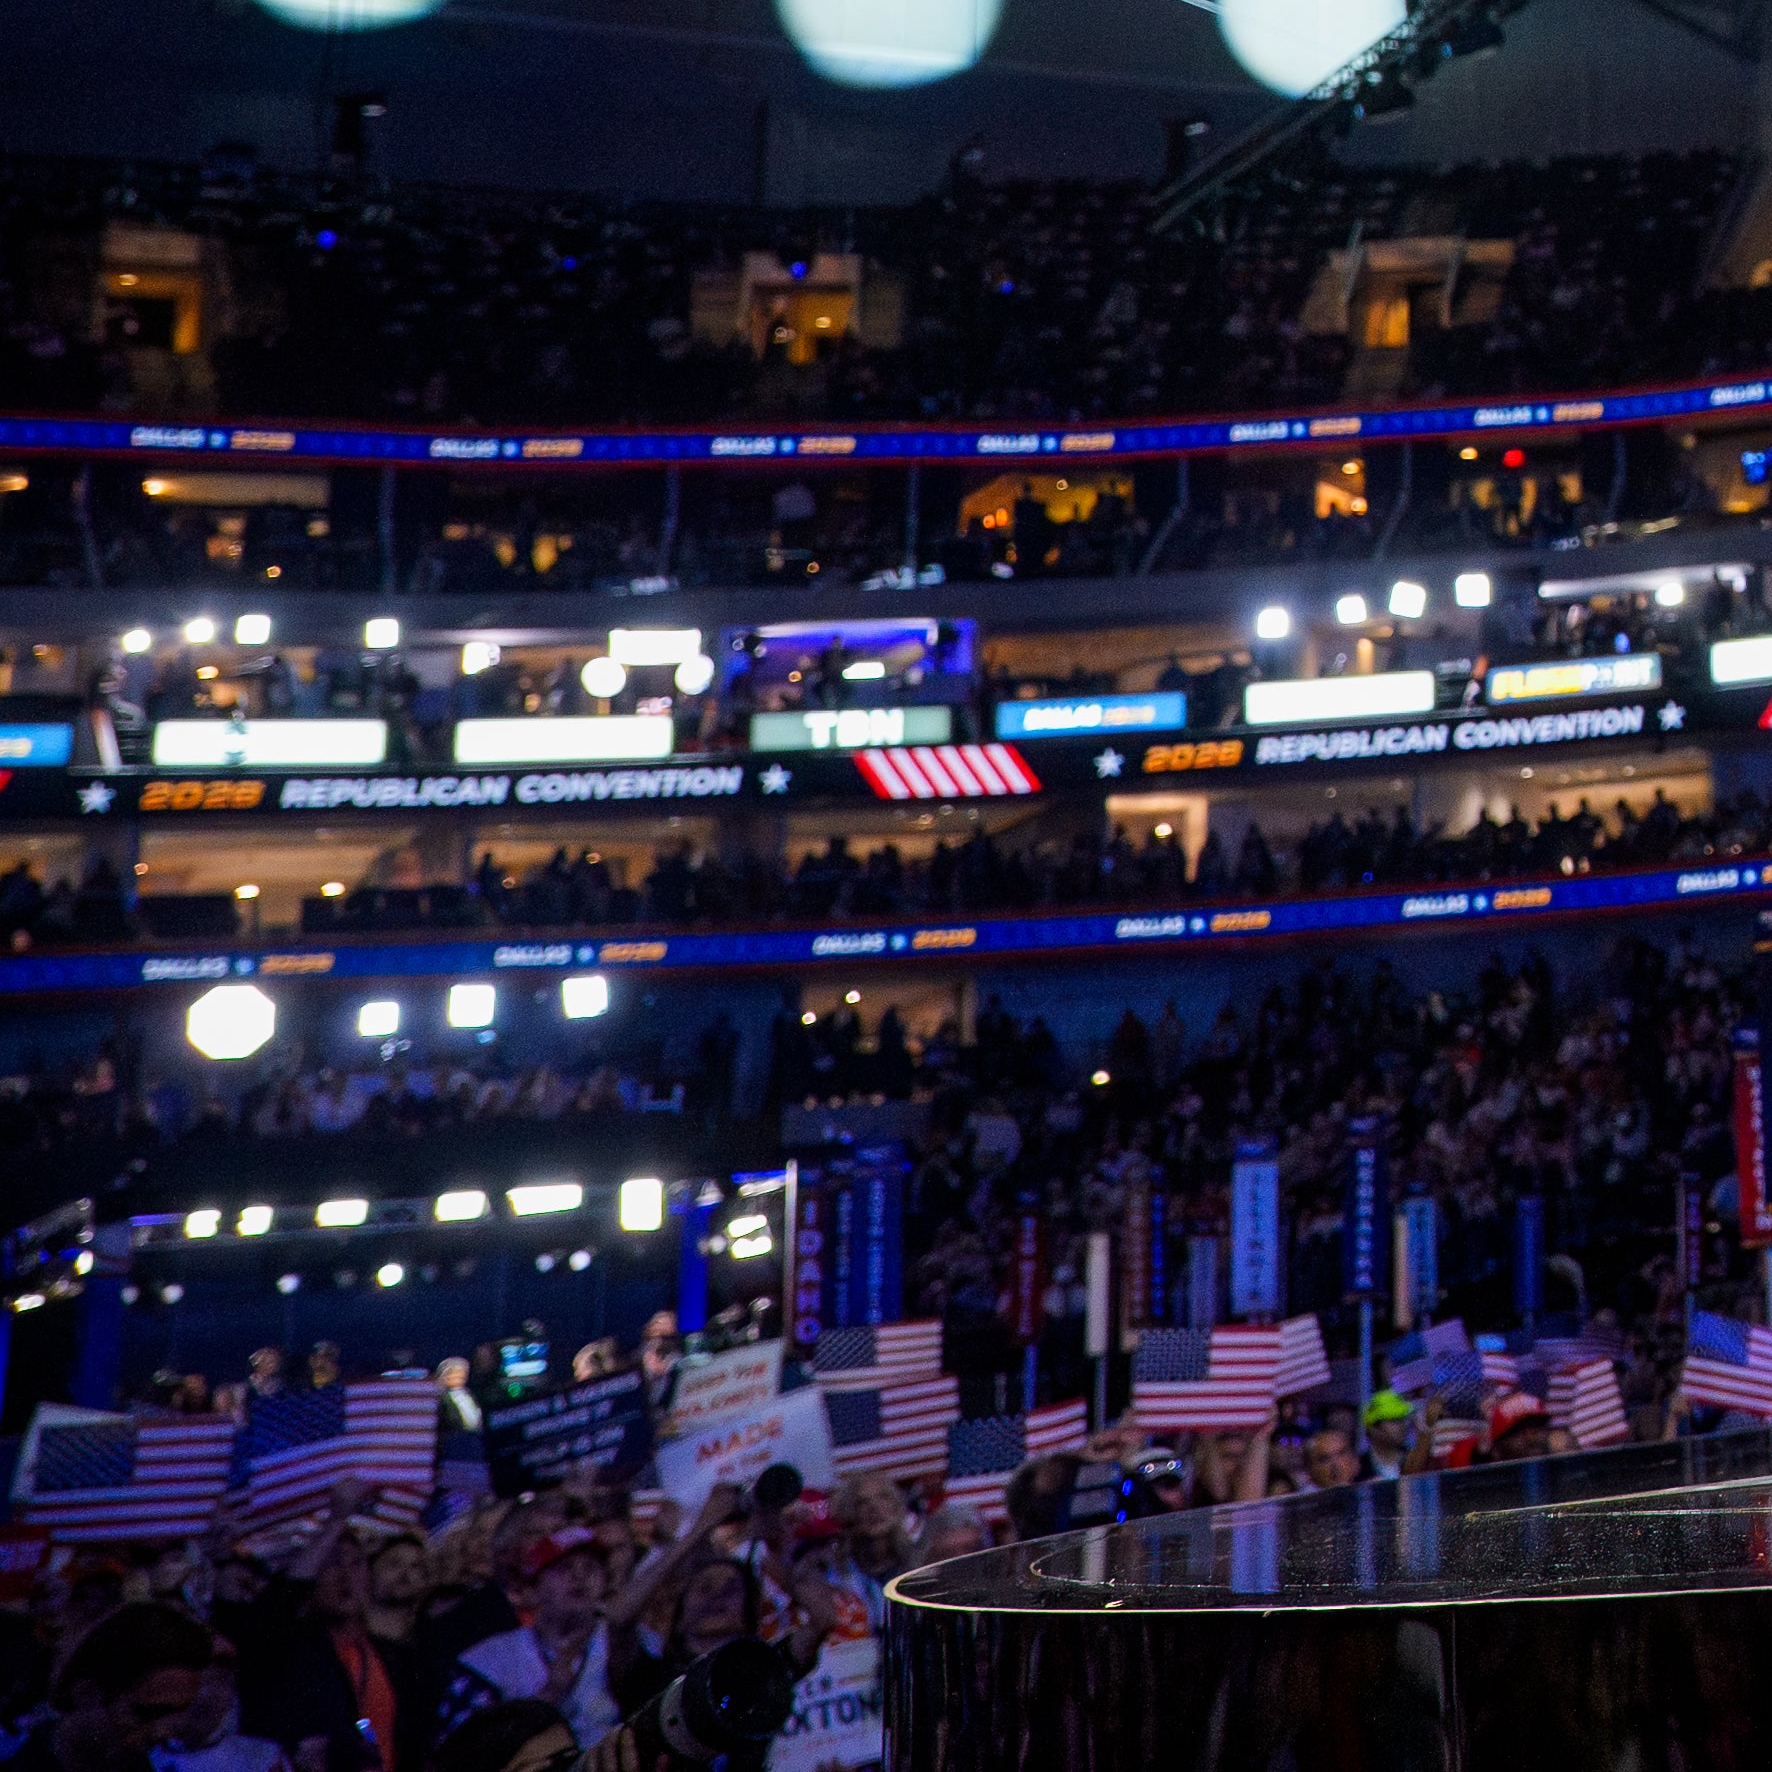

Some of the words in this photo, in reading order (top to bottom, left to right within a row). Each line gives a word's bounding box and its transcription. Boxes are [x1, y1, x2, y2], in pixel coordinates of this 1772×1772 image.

[1256, 724, 1449, 764] REPUBLICAN
[1452, 705, 1644, 750] CONVENTION
[281, 776, 511, 808] REPUBLICAN
[513, 760, 743, 803] CONVENTION
[494, 945, 571, 966] DALLAS
[813, 933, 885, 954] DALLAS
[795, 1198, 824, 1345] IDAHO
[696, 1416, 783, 1463] MADE
